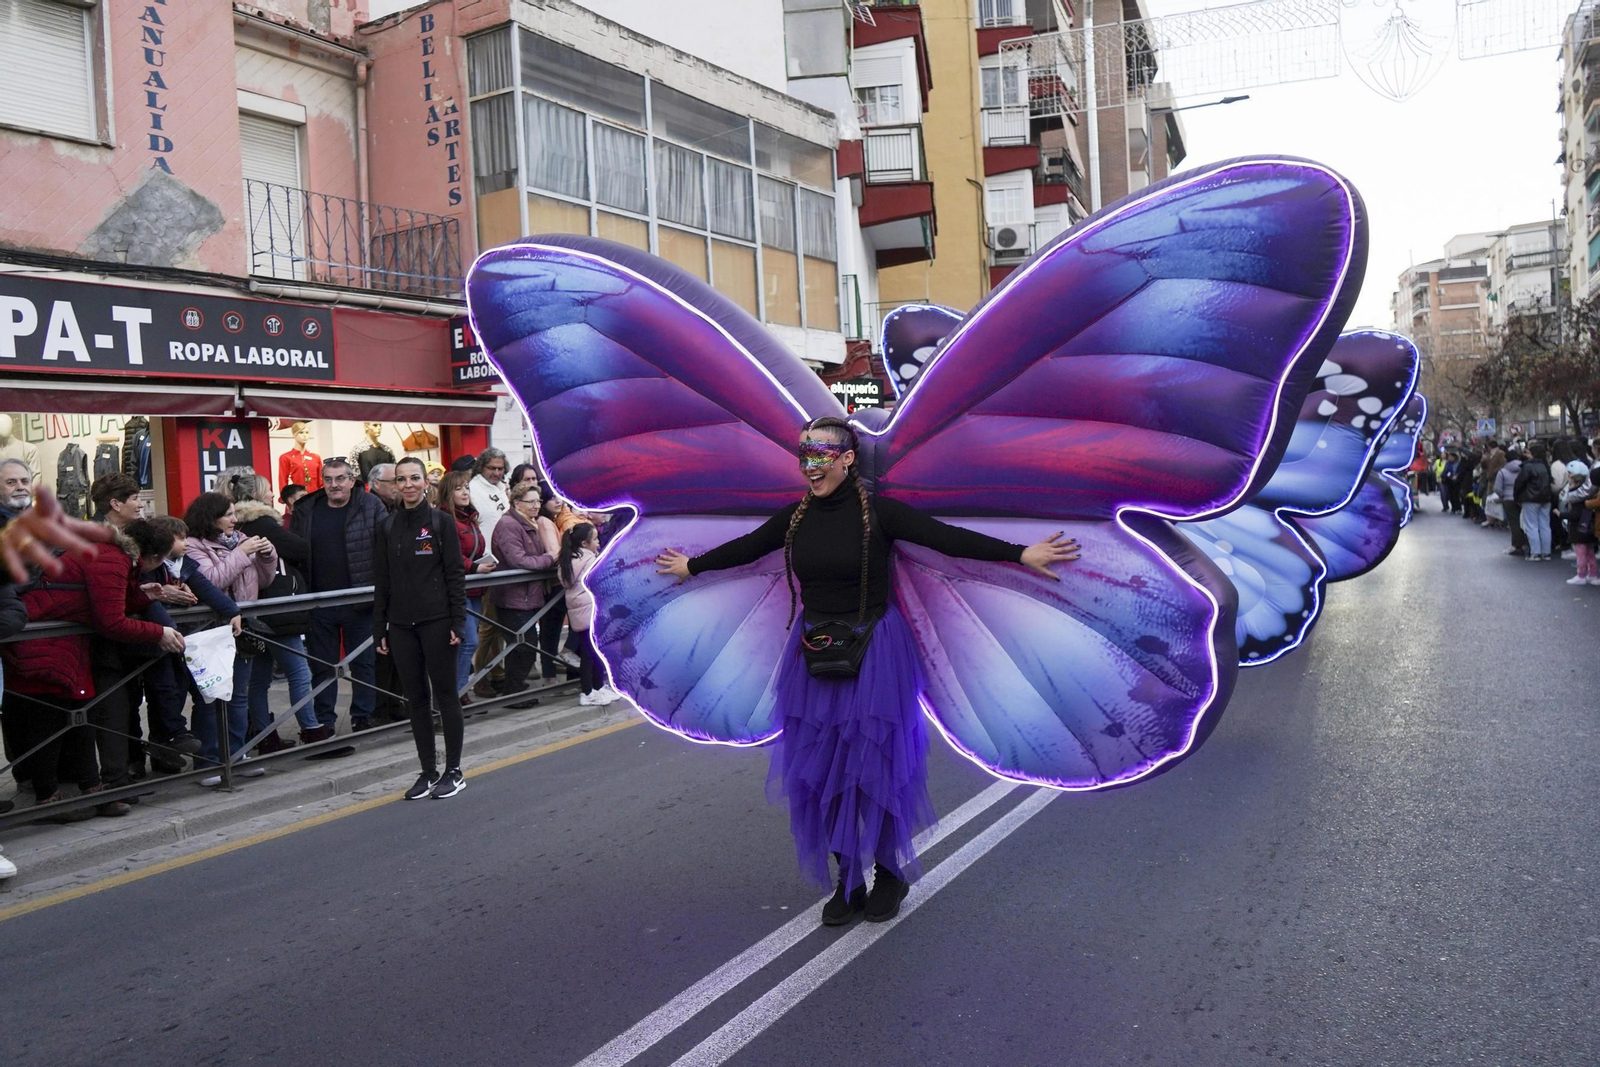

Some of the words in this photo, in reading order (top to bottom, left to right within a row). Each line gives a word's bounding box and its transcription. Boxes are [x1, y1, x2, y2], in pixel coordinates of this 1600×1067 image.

[443, 96, 462, 207] ARTES
[169, 341, 230, 363] ROPA
[234, 345, 329, 369] LABORAL
[460, 366, 498, 379] LABOR
[827, 381, 879, 397] eluquería
[201, 428, 244, 450] KA
